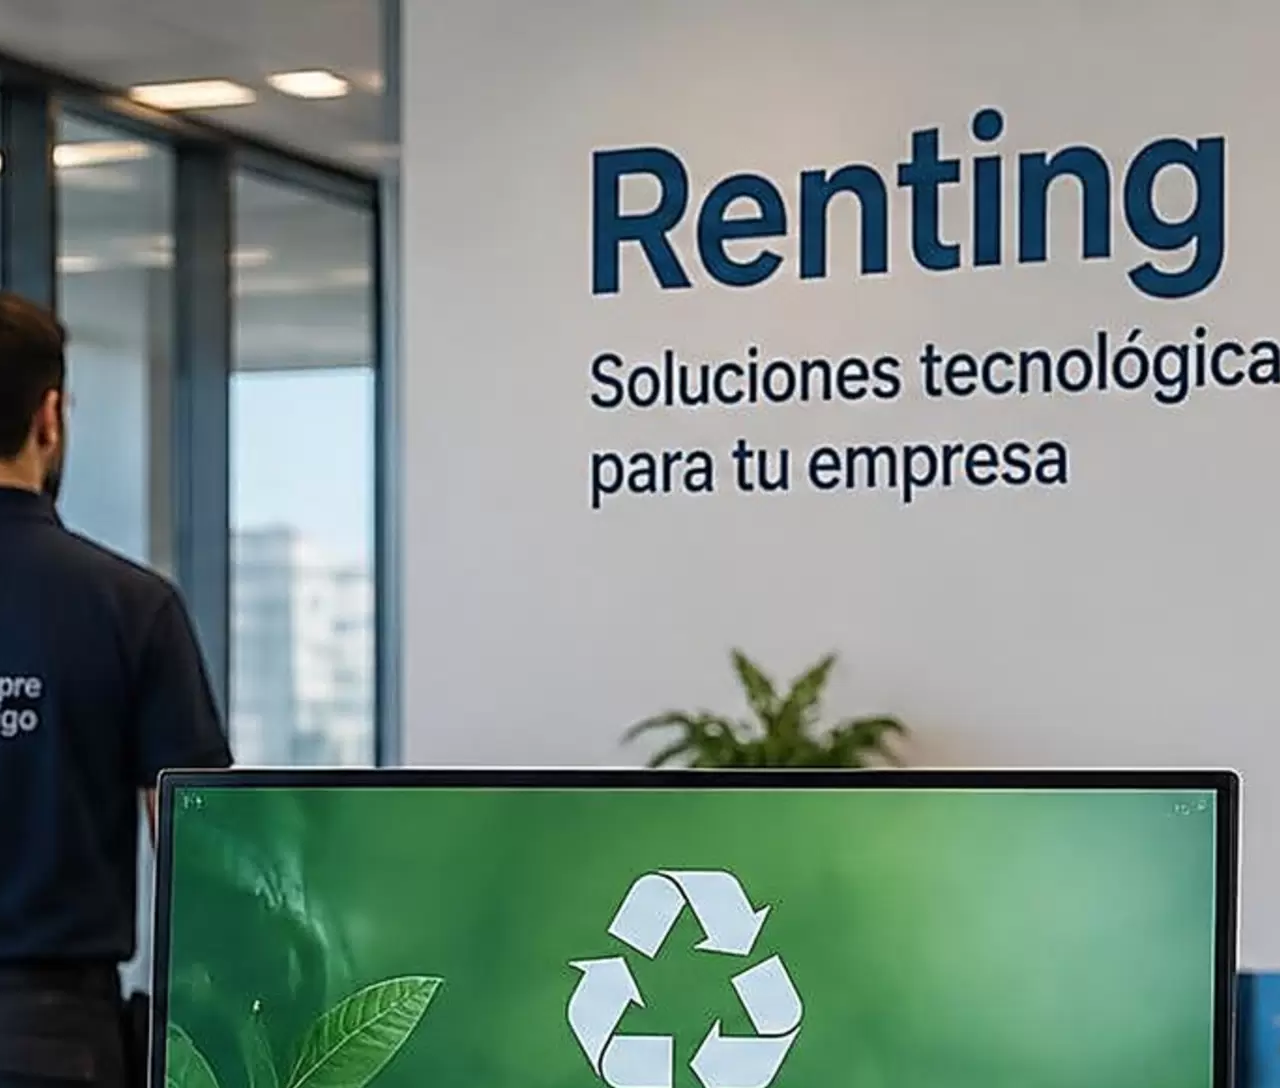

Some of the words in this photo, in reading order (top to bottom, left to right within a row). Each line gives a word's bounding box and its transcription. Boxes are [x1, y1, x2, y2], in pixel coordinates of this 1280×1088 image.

[592, 108, 1226, 299] Renting
[591, 346, 901, 408] Soluciones
[592, 450, 714, 510] para
[732, 439, 789, 491] tu
[808, 441, 1067, 504] empresa
